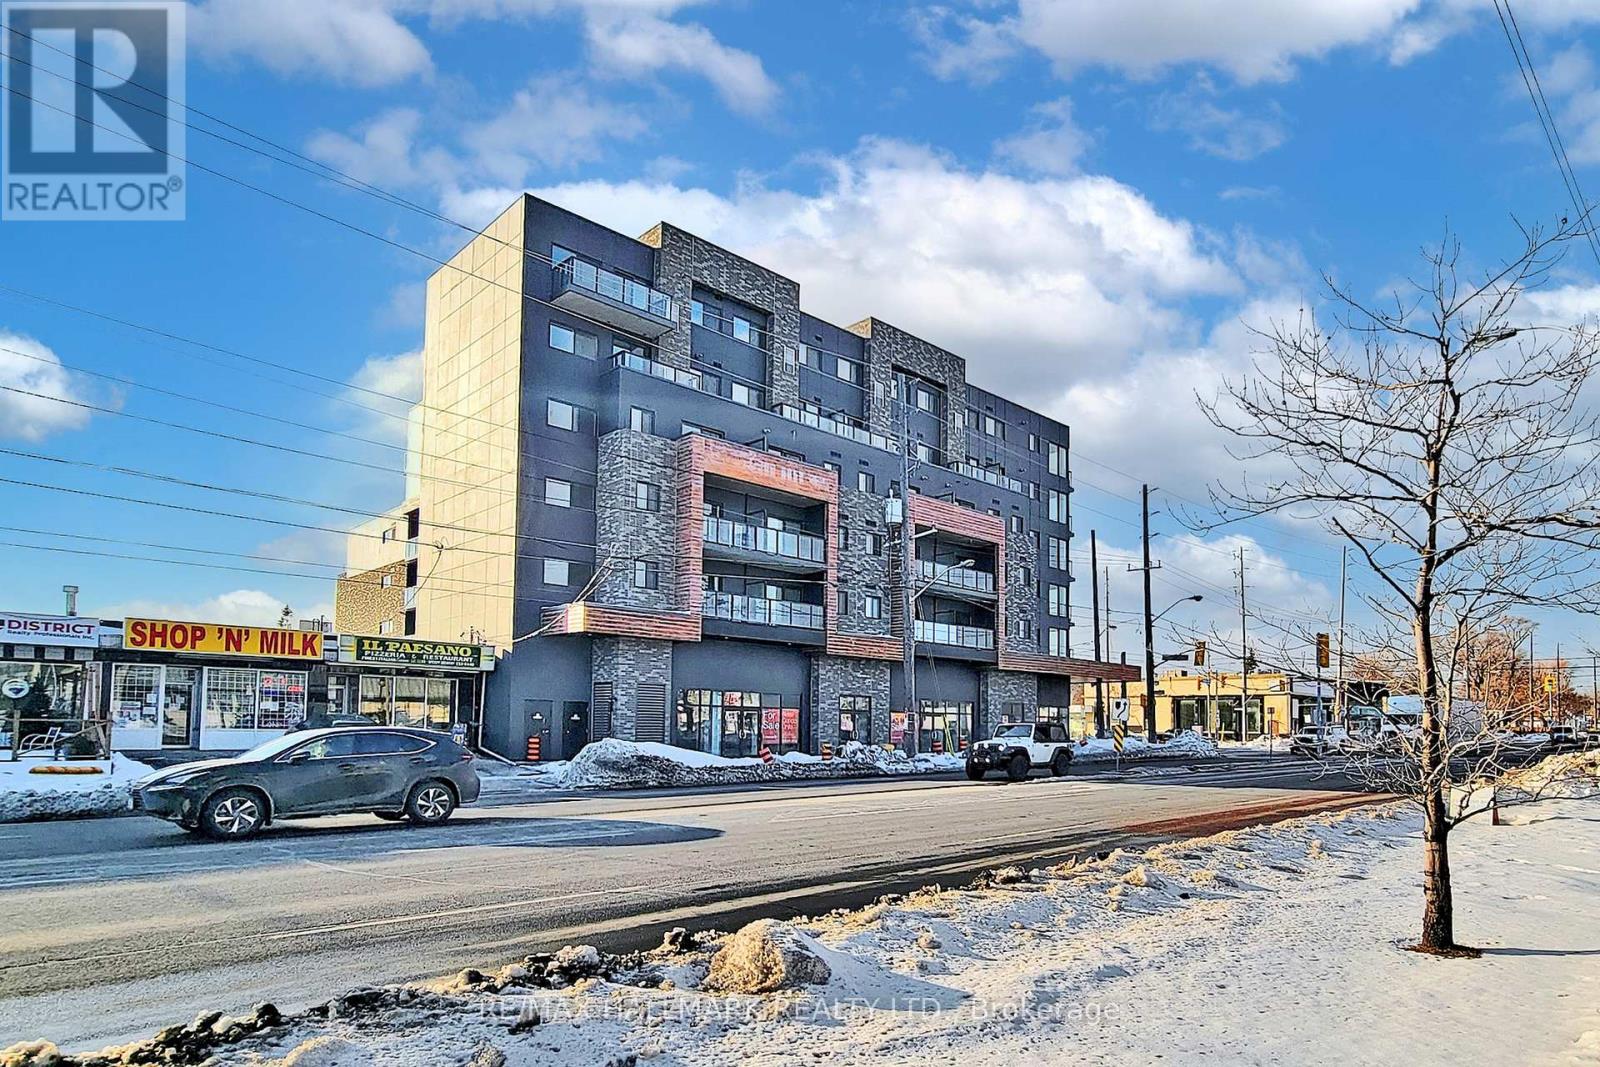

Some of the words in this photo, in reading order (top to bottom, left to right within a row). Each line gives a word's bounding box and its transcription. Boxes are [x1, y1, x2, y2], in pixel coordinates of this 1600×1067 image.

[8, 620, 96, 634] DISTRICT
[130, 621, 206, 649] SHOP
[217, 627, 250, 652] 'N'
[259, 630, 320, 656] MILK
[362, 639, 383, 651] IL
[385, 641, 472, 657] PAESANO
[364, 650, 406, 659] PIZZERIA
[422, 654, 474, 663] RESTAURANT
[762, 709, 777, 720] For
[762, 720, 780, 730] Sale
